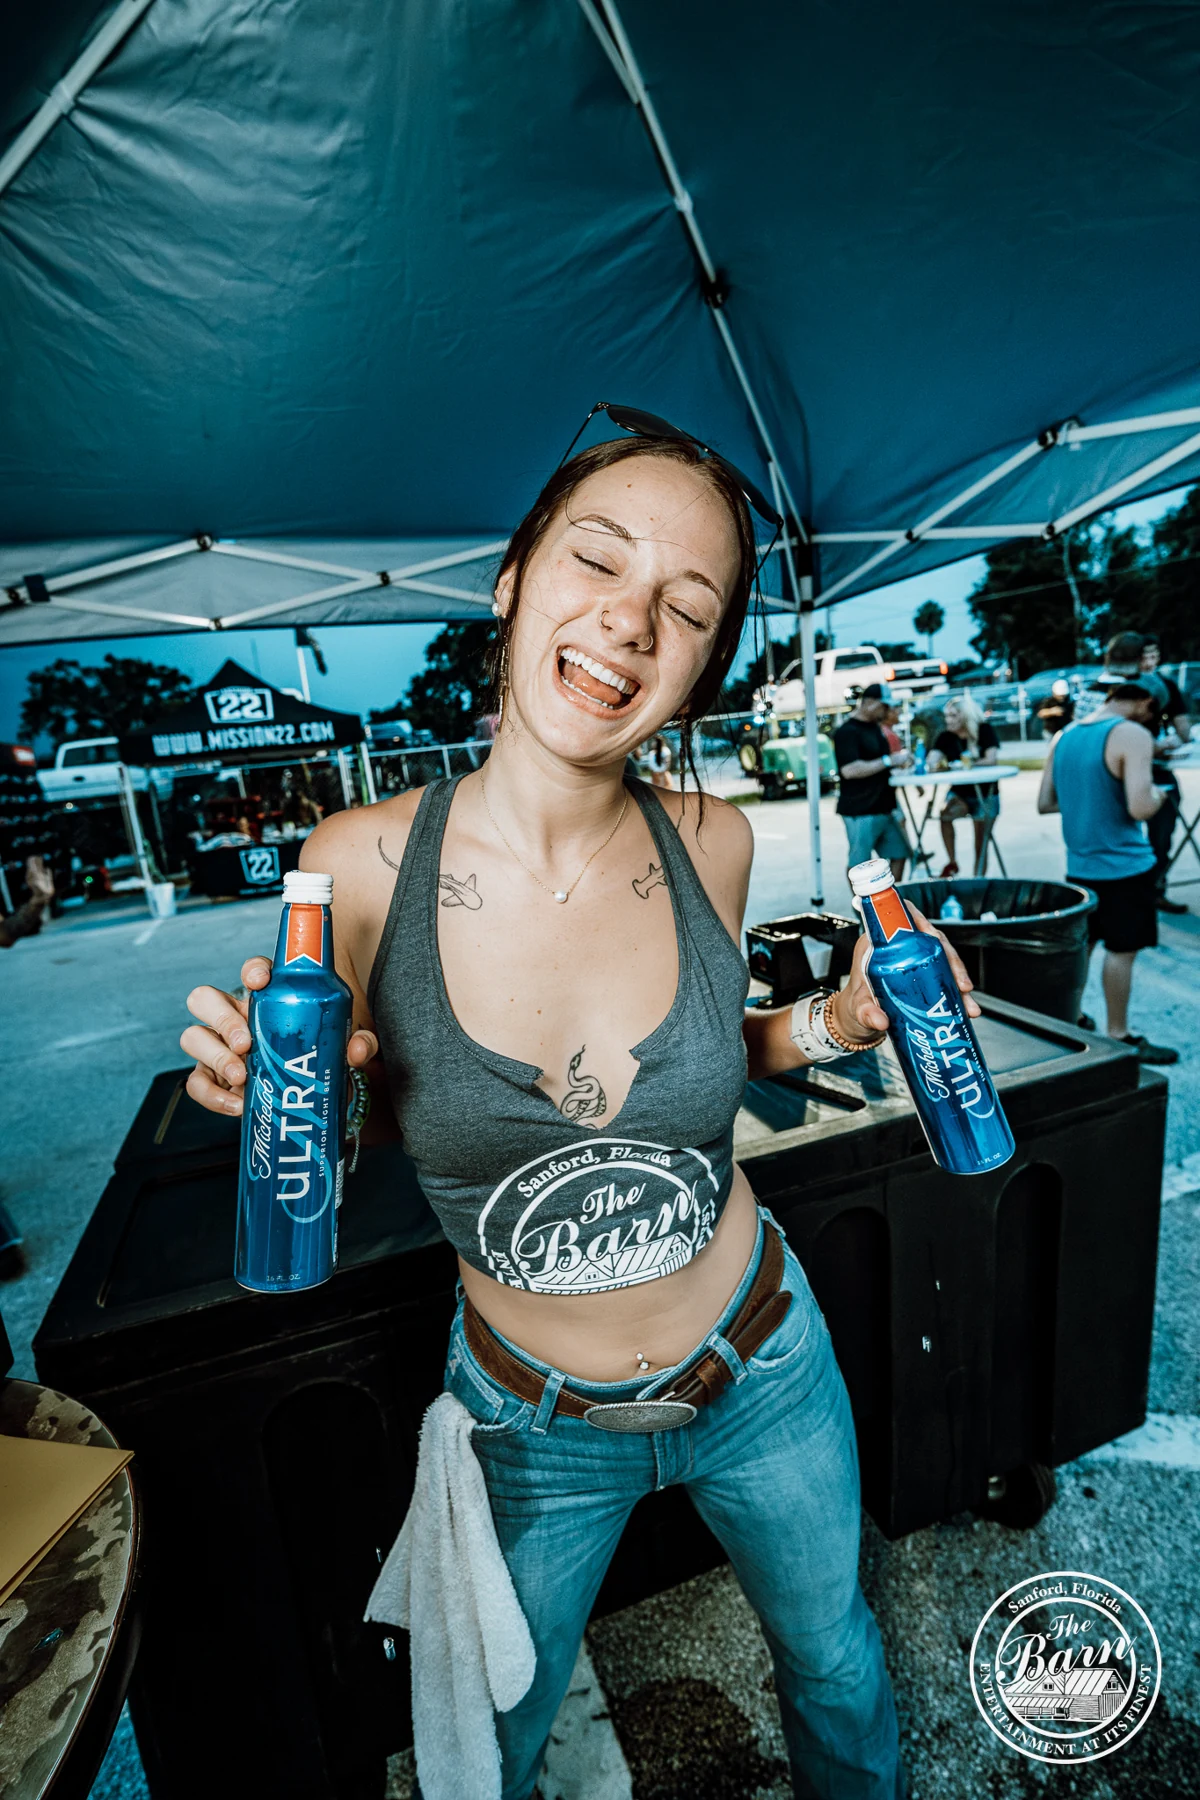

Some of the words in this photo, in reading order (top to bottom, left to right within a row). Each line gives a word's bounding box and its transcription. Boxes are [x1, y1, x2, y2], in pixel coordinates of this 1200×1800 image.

[218, 692, 265, 720] 22
[152, 720, 335, 756] WWW.MISSION22.COM
[248, 852, 274, 880] 22
[906, 1025, 950, 1098] Michelob
[926, 994, 982, 1109] ULTRA
[252, 1067, 274, 1179] Michelob
[276, 1049, 318, 1200] ULTRA
[319, 1130, 327, 1177] SUPERIOR
[517, 1149, 601, 1198] Sanford,
[516, 1180, 698, 1275] Barn
[580, 1183, 646, 1224] The
